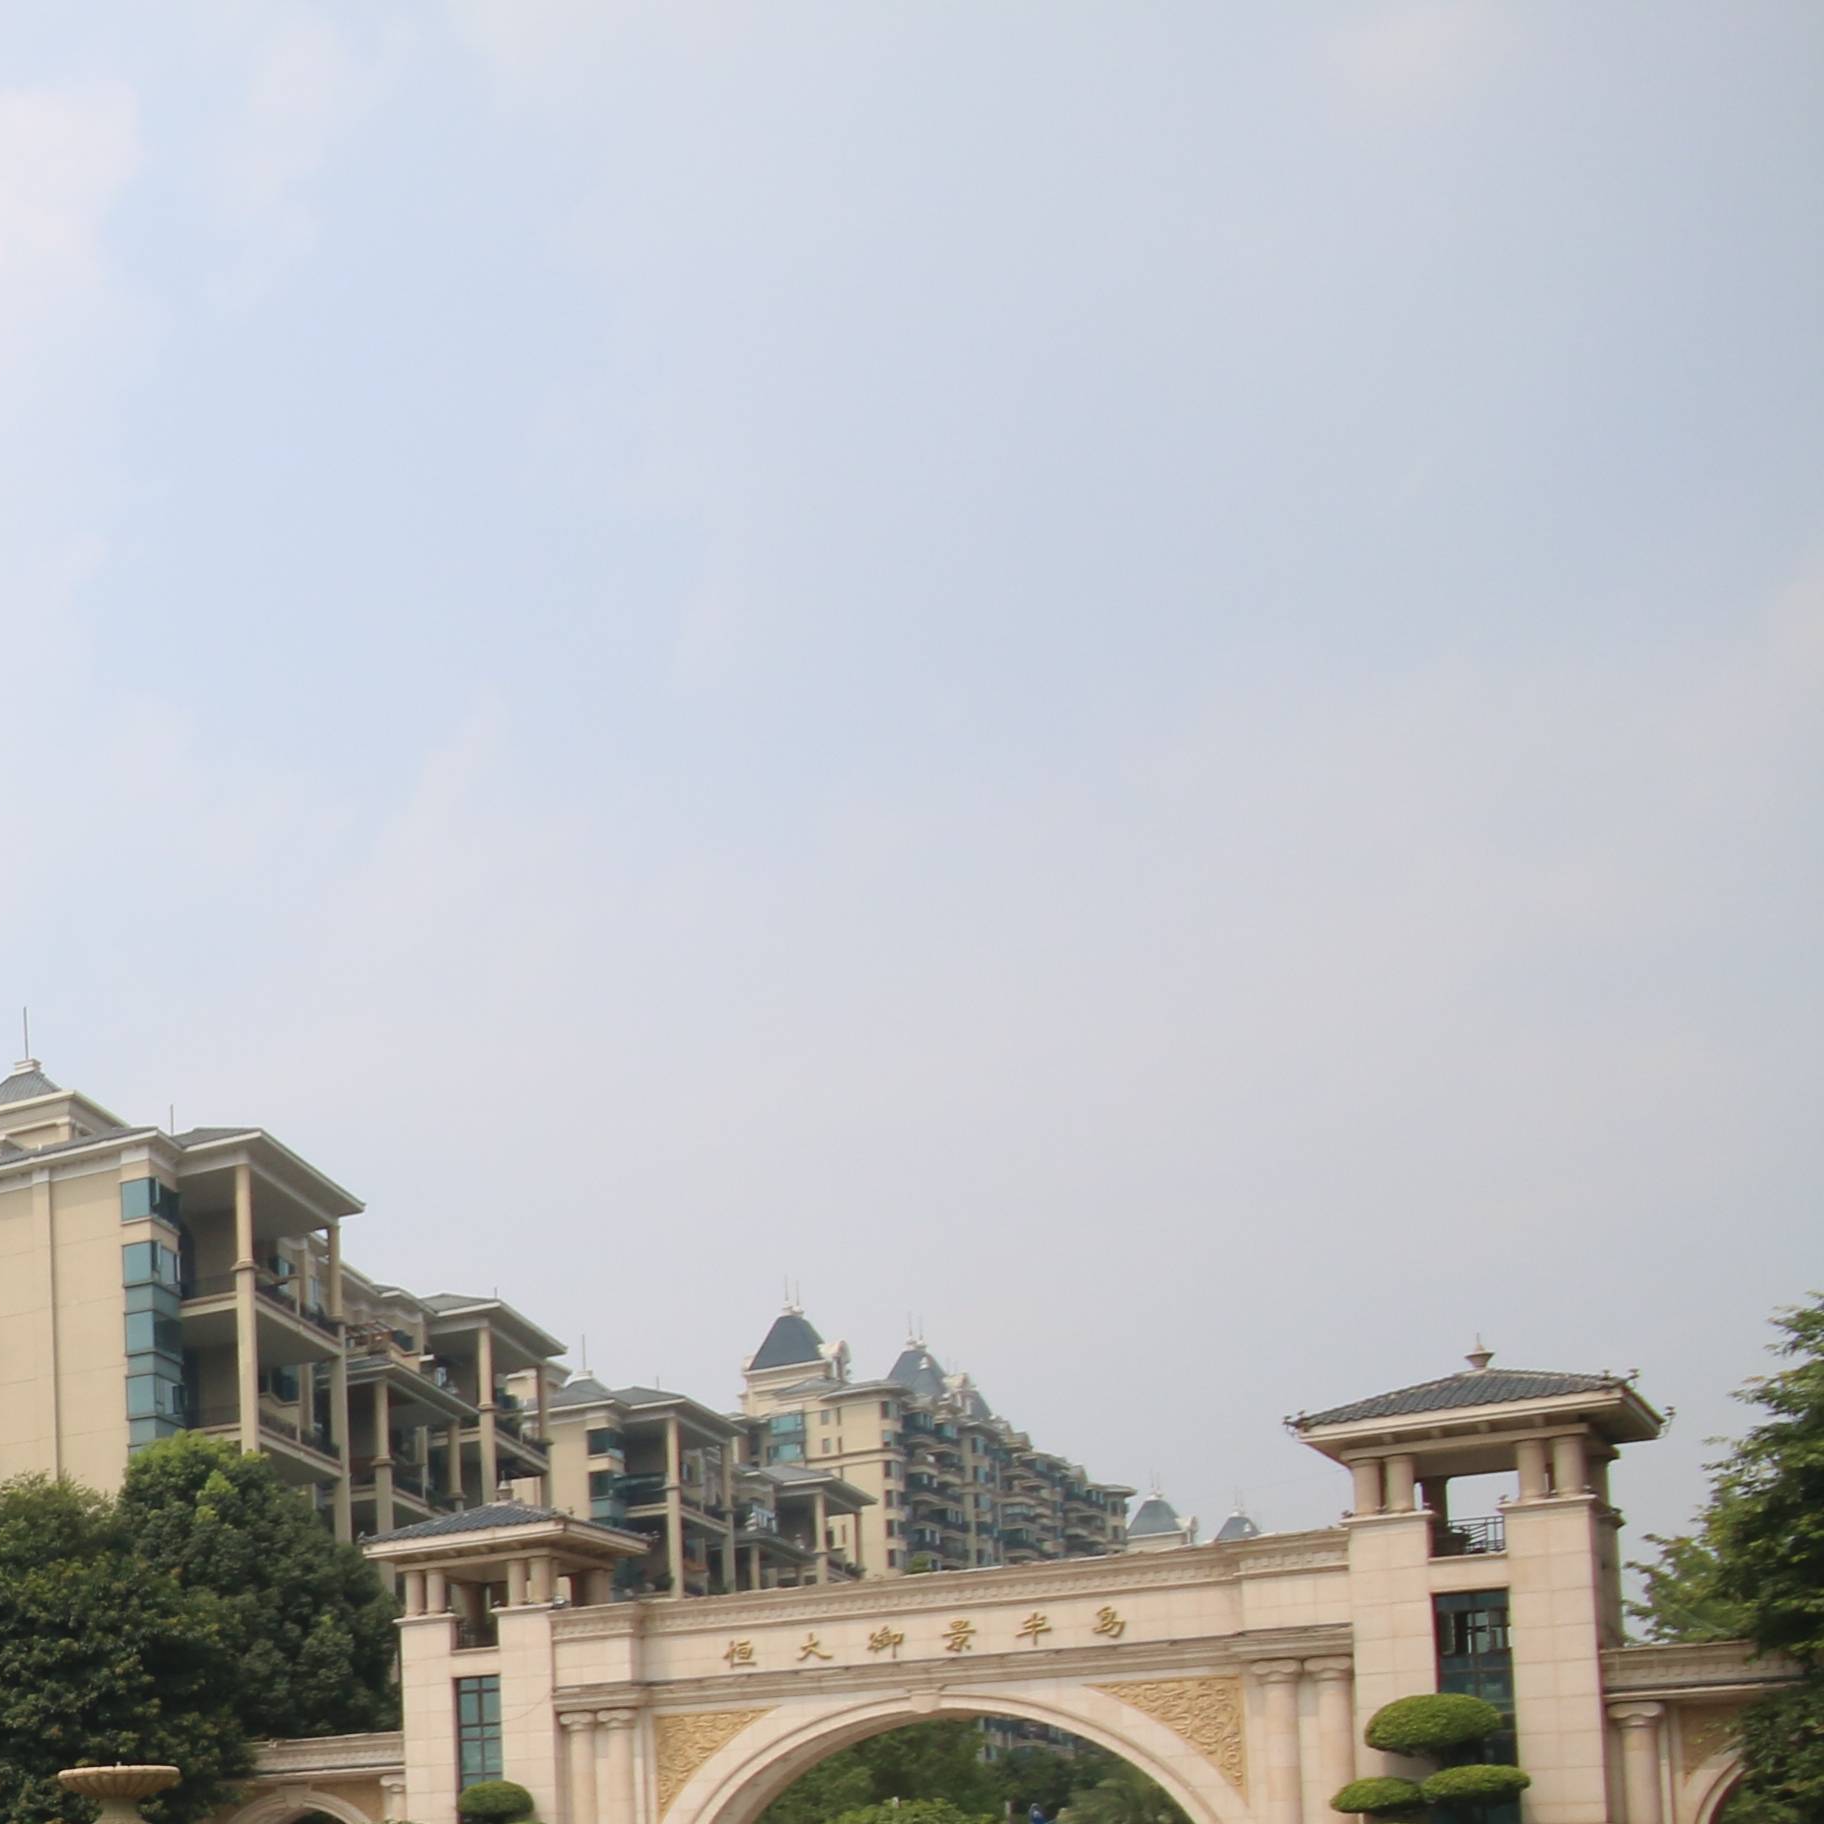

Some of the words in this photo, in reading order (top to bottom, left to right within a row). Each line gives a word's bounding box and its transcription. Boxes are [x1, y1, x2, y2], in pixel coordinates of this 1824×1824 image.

[723, 1605, 1126, 1668] 恒大御景半岛
